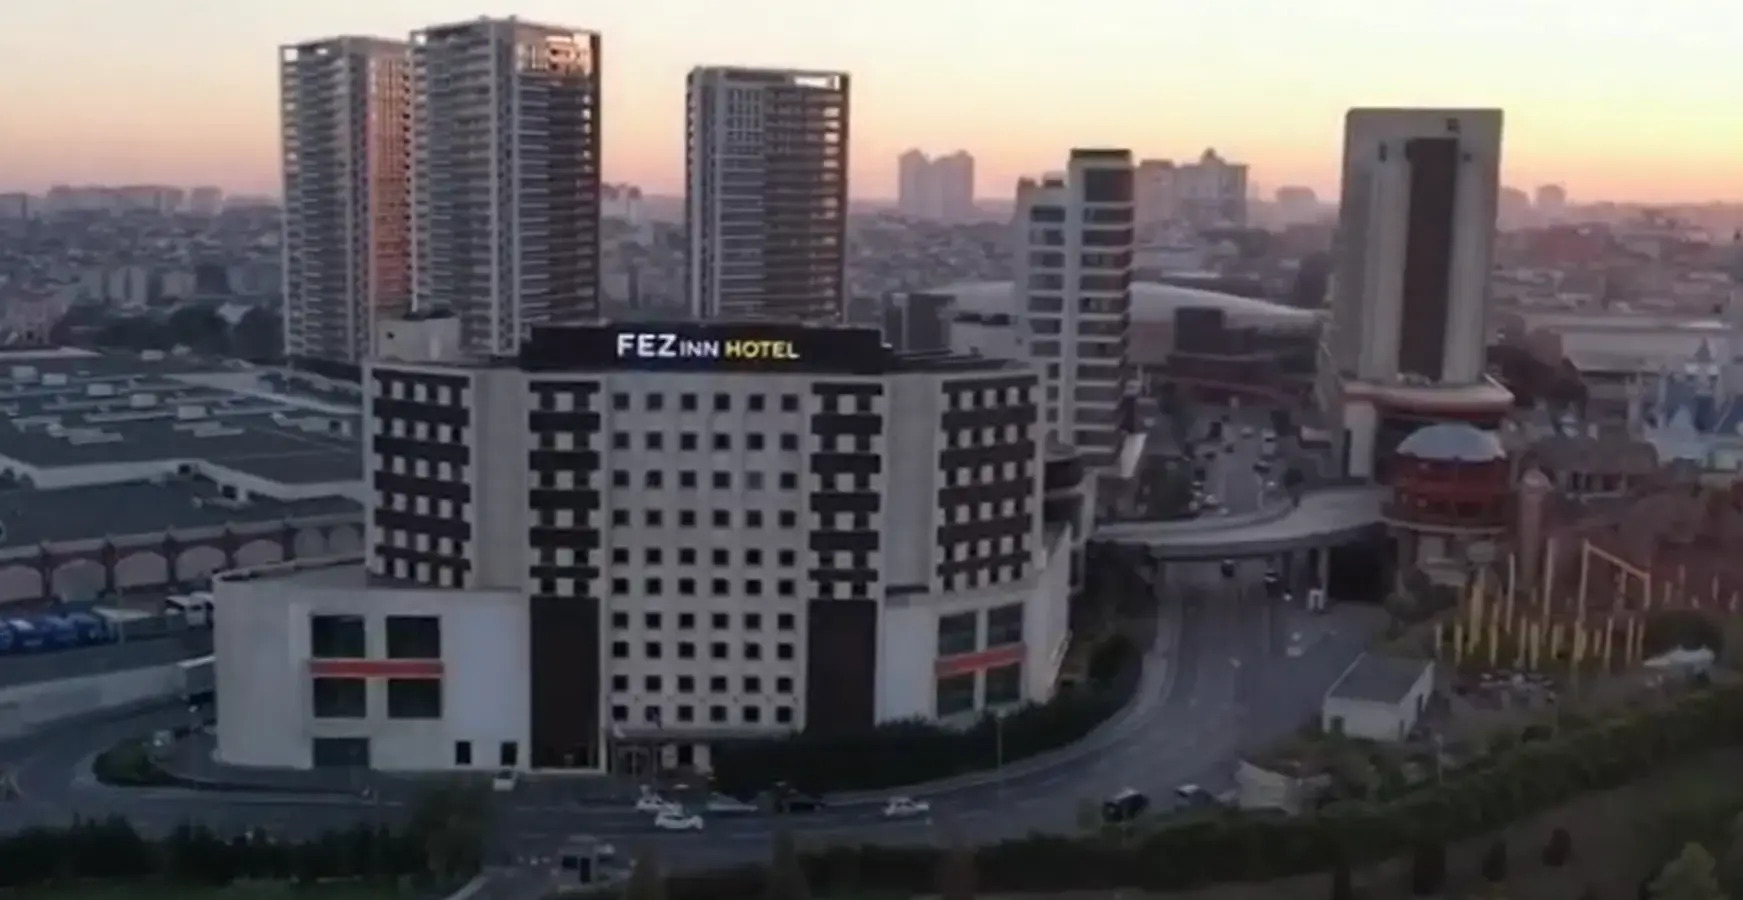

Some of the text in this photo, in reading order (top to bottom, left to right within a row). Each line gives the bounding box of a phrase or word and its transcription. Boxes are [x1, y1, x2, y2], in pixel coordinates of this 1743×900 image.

[617, 333, 800, 358] FEZ INN HOTEL
